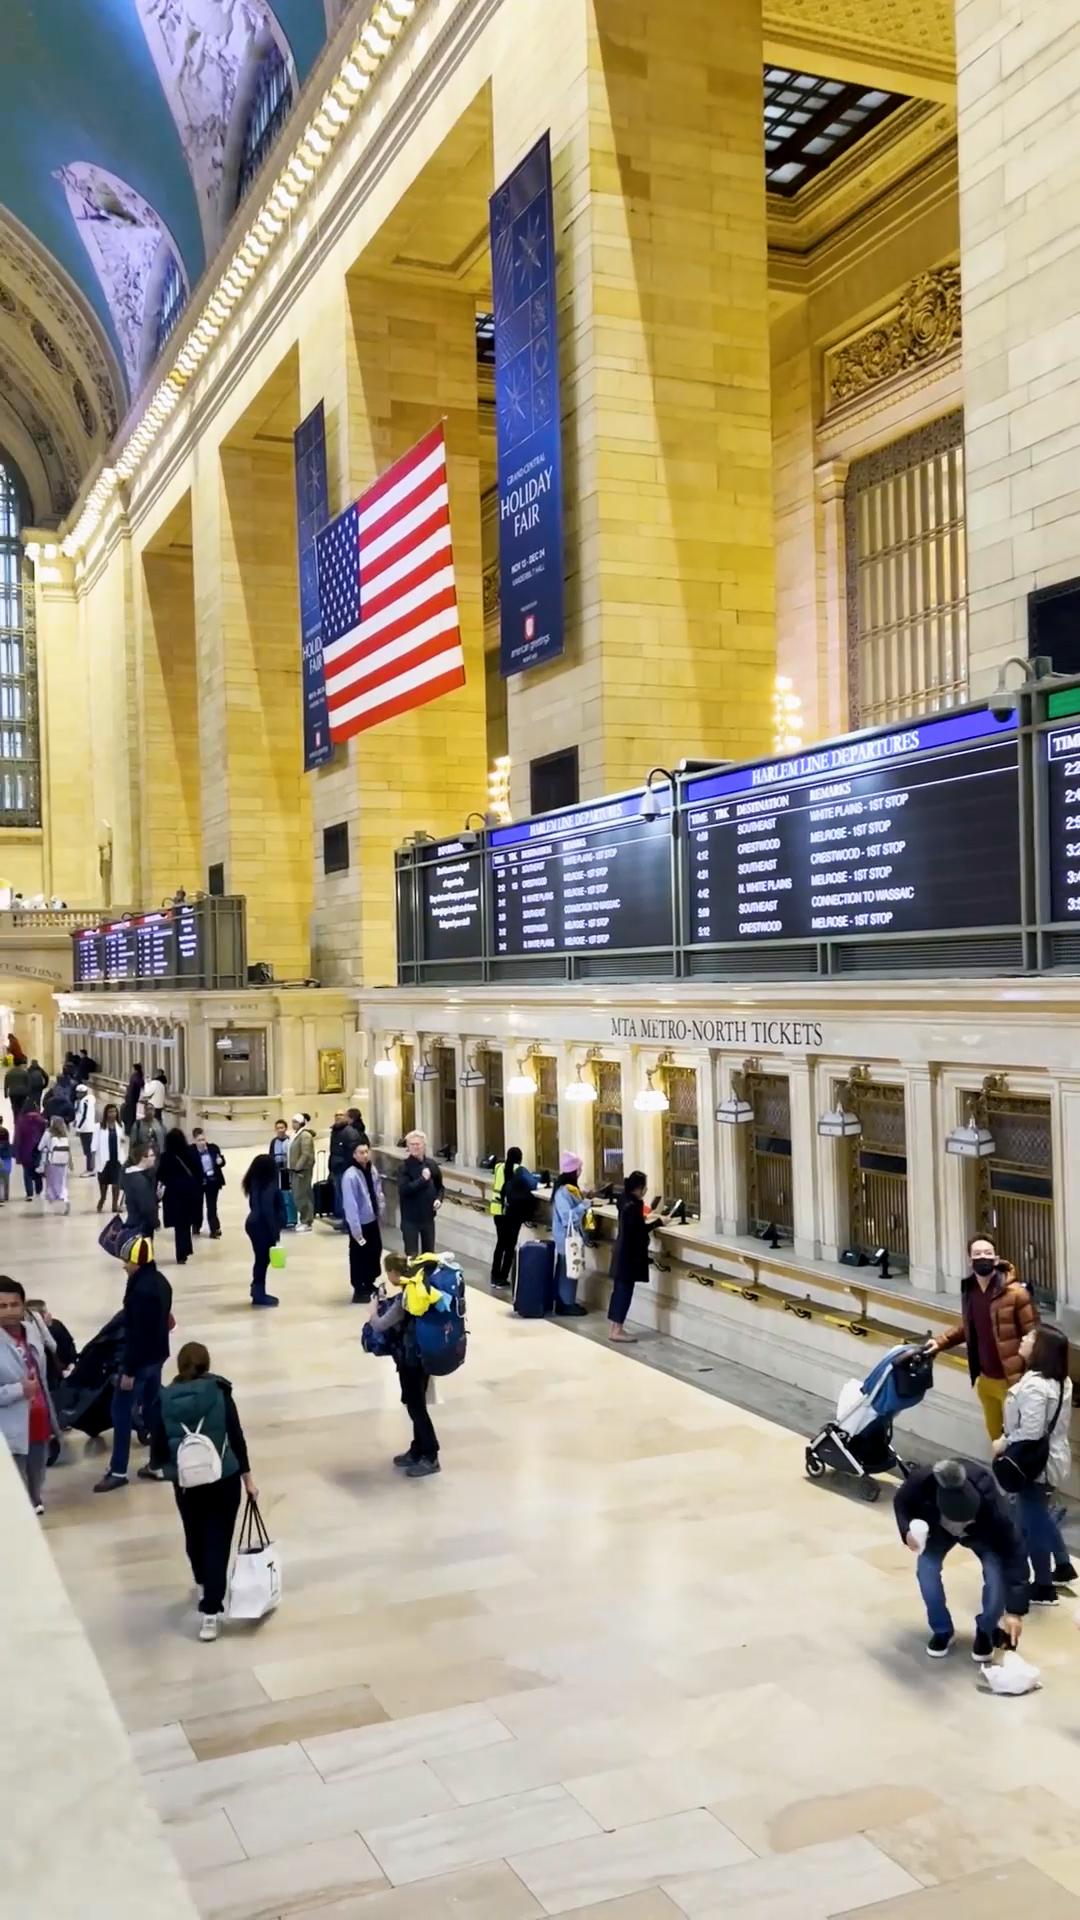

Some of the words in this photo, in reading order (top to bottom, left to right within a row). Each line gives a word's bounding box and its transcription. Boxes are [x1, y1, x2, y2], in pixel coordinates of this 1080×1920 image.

[501, 464, 553, 521] HOLIDAY
[514, 503, 540, 538] FAIR
[752, 760, 800, 787] HARLEM
[801, 751, 831, 772] LINE
[831, 730, 921, 768] DEPARTURES
[1053, 733, 1080, 752] TIM
[736, 794, 790, 816] DESTINATION
[809, 781, 852, 801] REMARKS
[737, 817, 777, 835] SOUTHEAST
[809, 807, 834, 822] WHITE
[834, 801, 863, 818] PLAINS
[869, 797, 884, 812] 1ST
[884, 792, 909, 809] STOP
[737, 838, 781, 855] CRESTWOOD
[810, 826, 847, 844] MELROSE
[852, 823, 868, 837] 1ST
[868, 819, 892, 835] STOP
[737, 858, 778, 875] SOUTHEAST
[810, 847, 861, 865] CRESTWOOD
[866, 843, 882, 858] 1ST
[882, 840, 906, 856] STOP
[746, 880, 767, 893] WHITE
[767, 877, 793, 891] PLAINS
[811, 870, 848, 886] MELROSE
[853, 868, 868, 881] 1ST
[868, 866, 893, 880] STOP
[738, 899, 779, 915] SOUTHEAST
[811, 891, 862, 908] CONNECTION
[862, 890, 875, 903] TO
[875, 885, 915, 901] WASSAIC
[738, 920, 783, 934] CRESTWOOD
[811, 915, 849, 929] MELROSE
[854, 912, 869, 926] 1ST
[869, 911, 894, 926] STOP
[611, 1017, 637, 1037] MTA
[640, 1018, 746, 1043] METRO-NORTH
[751, 1021, 823, 1047] TICKETS
